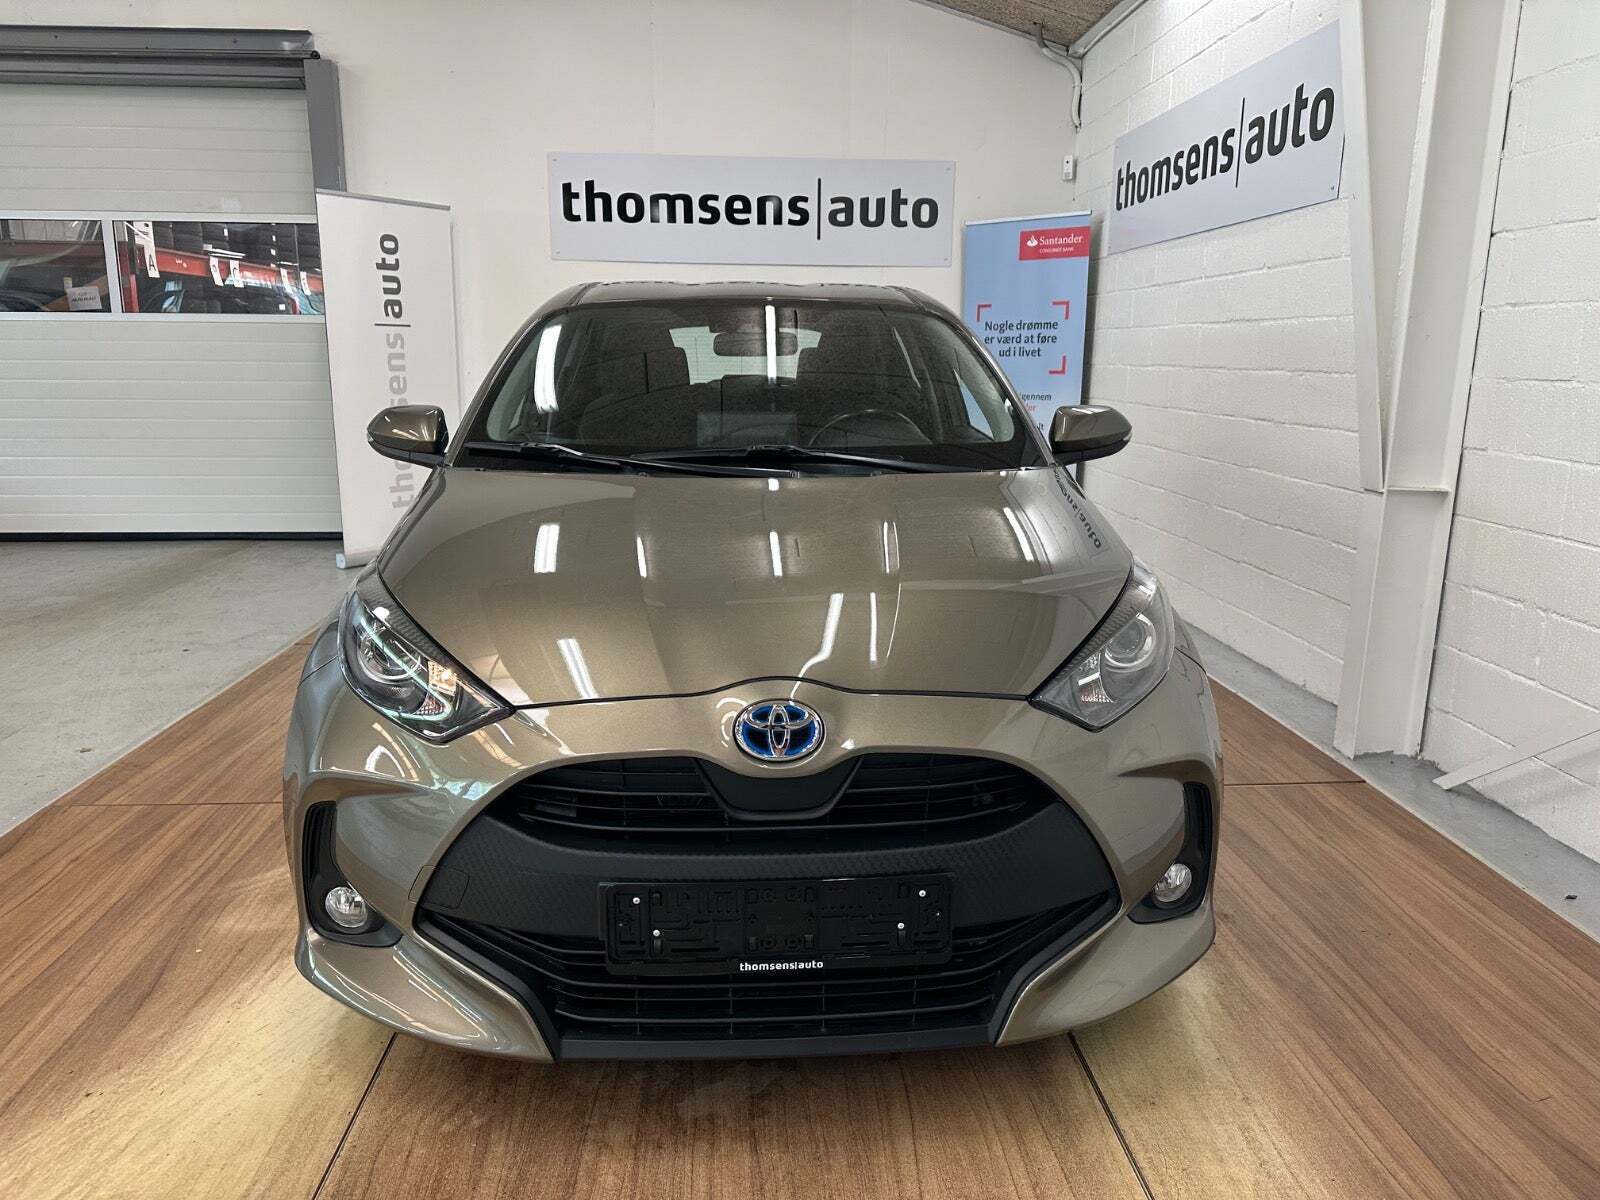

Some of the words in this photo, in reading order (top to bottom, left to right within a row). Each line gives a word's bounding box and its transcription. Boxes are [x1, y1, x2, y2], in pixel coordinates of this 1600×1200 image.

[1039, 233, 1083, 246] Santander
[984, 320, 1014, 334] Nogle
[1016, 320, 1059, 331] drømme
[984, 336, 995, 344] er
[997, 333, 1022, 344] værd
[1024, 334, 1034, 344] at
[1037, 333, 1058, 344] føre
[999, 347, 1011, 357] ud
[1018, 346, 1042, 357] livet
